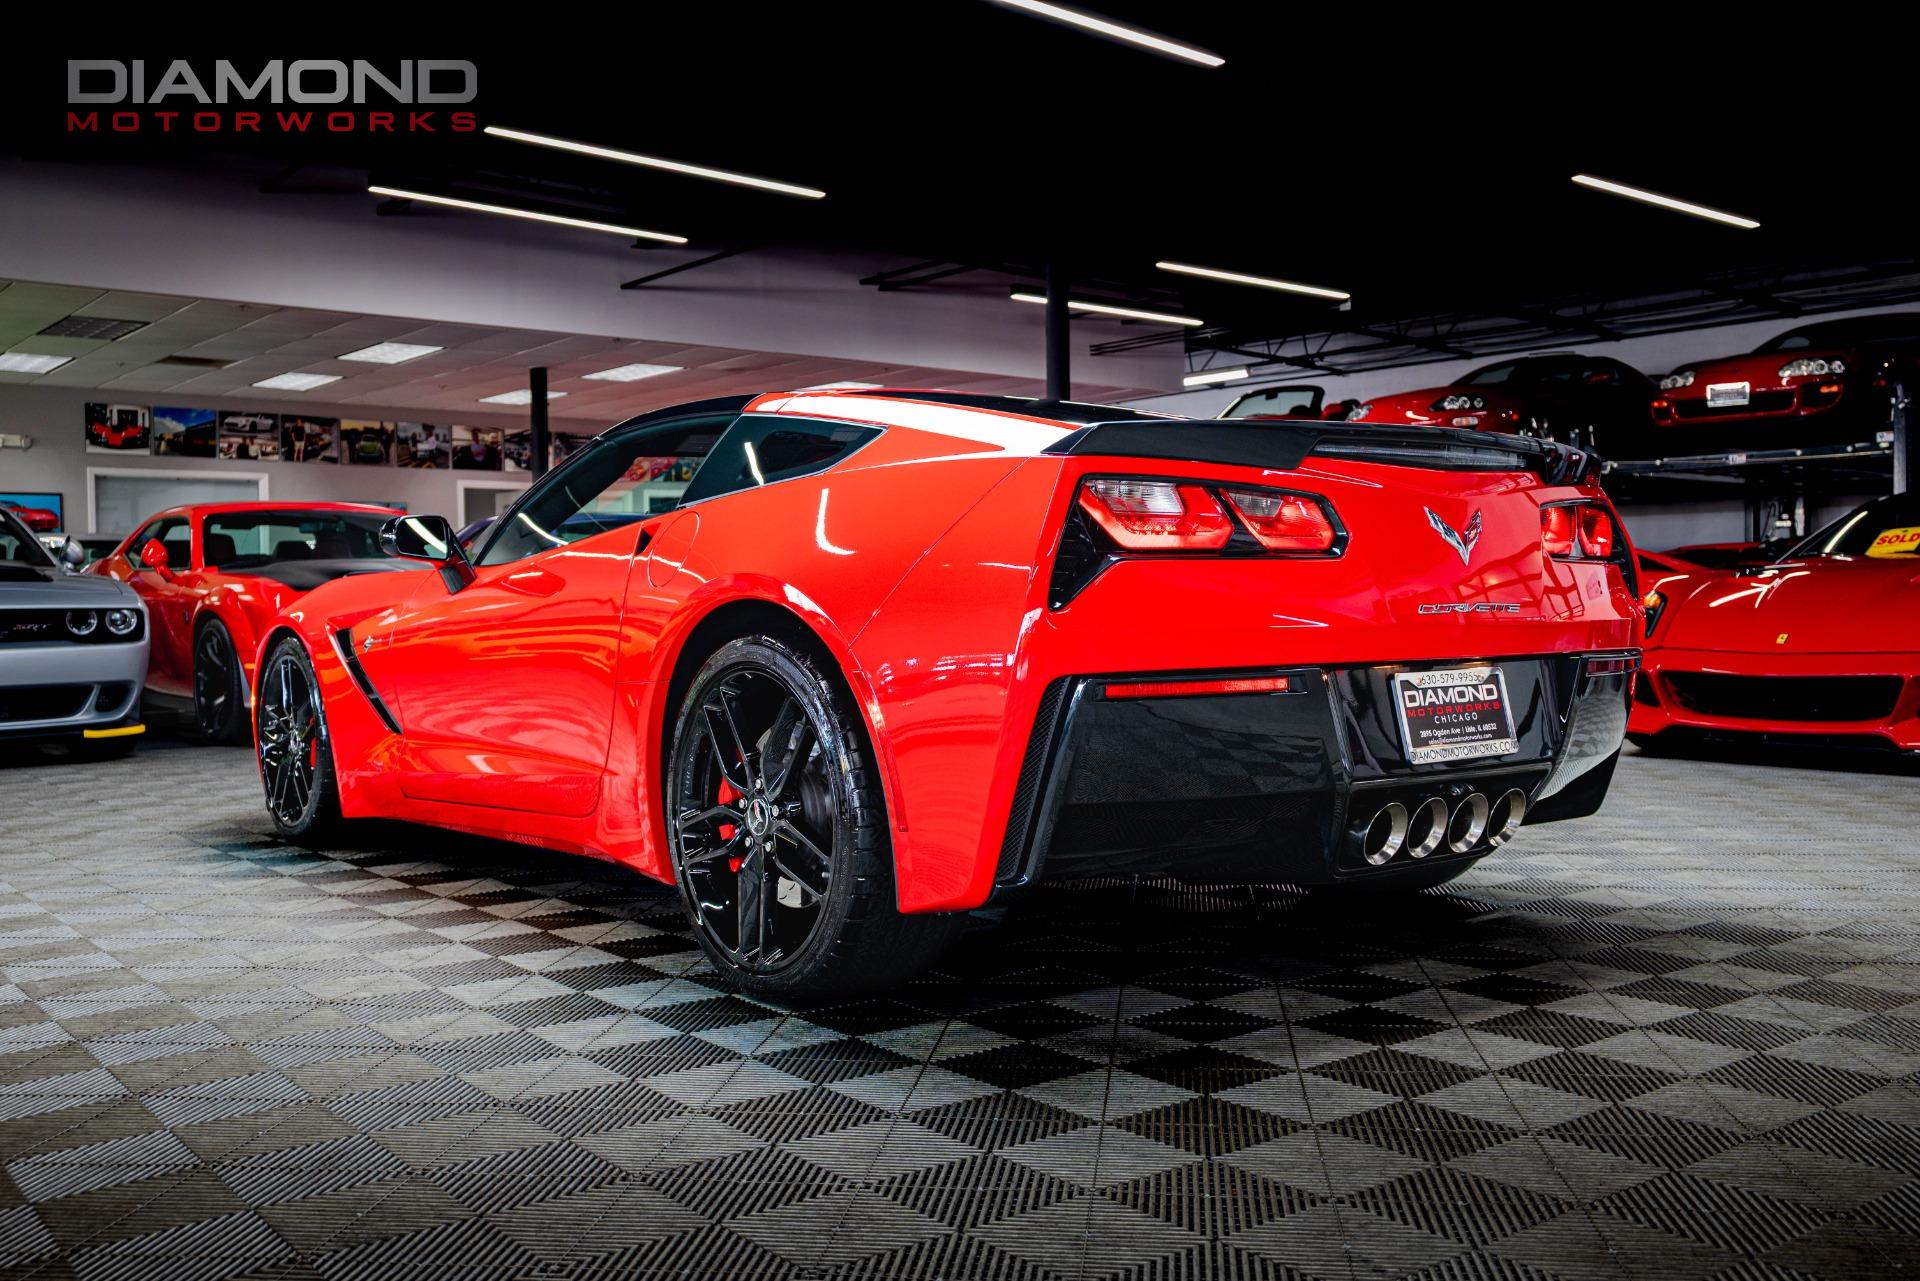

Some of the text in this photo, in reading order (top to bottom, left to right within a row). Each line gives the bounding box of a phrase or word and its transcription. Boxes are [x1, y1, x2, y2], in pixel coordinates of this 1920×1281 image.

[1877, 533, 1920, 545] SOLD
[1418, 602, 1521, 614] CORVETTE
[1403, 684, 1498, 708] DIAMOND
[1407, 701, 1501, 718] MOTORWORKS
[1434, 712, 1478, 724] CHICAGO
